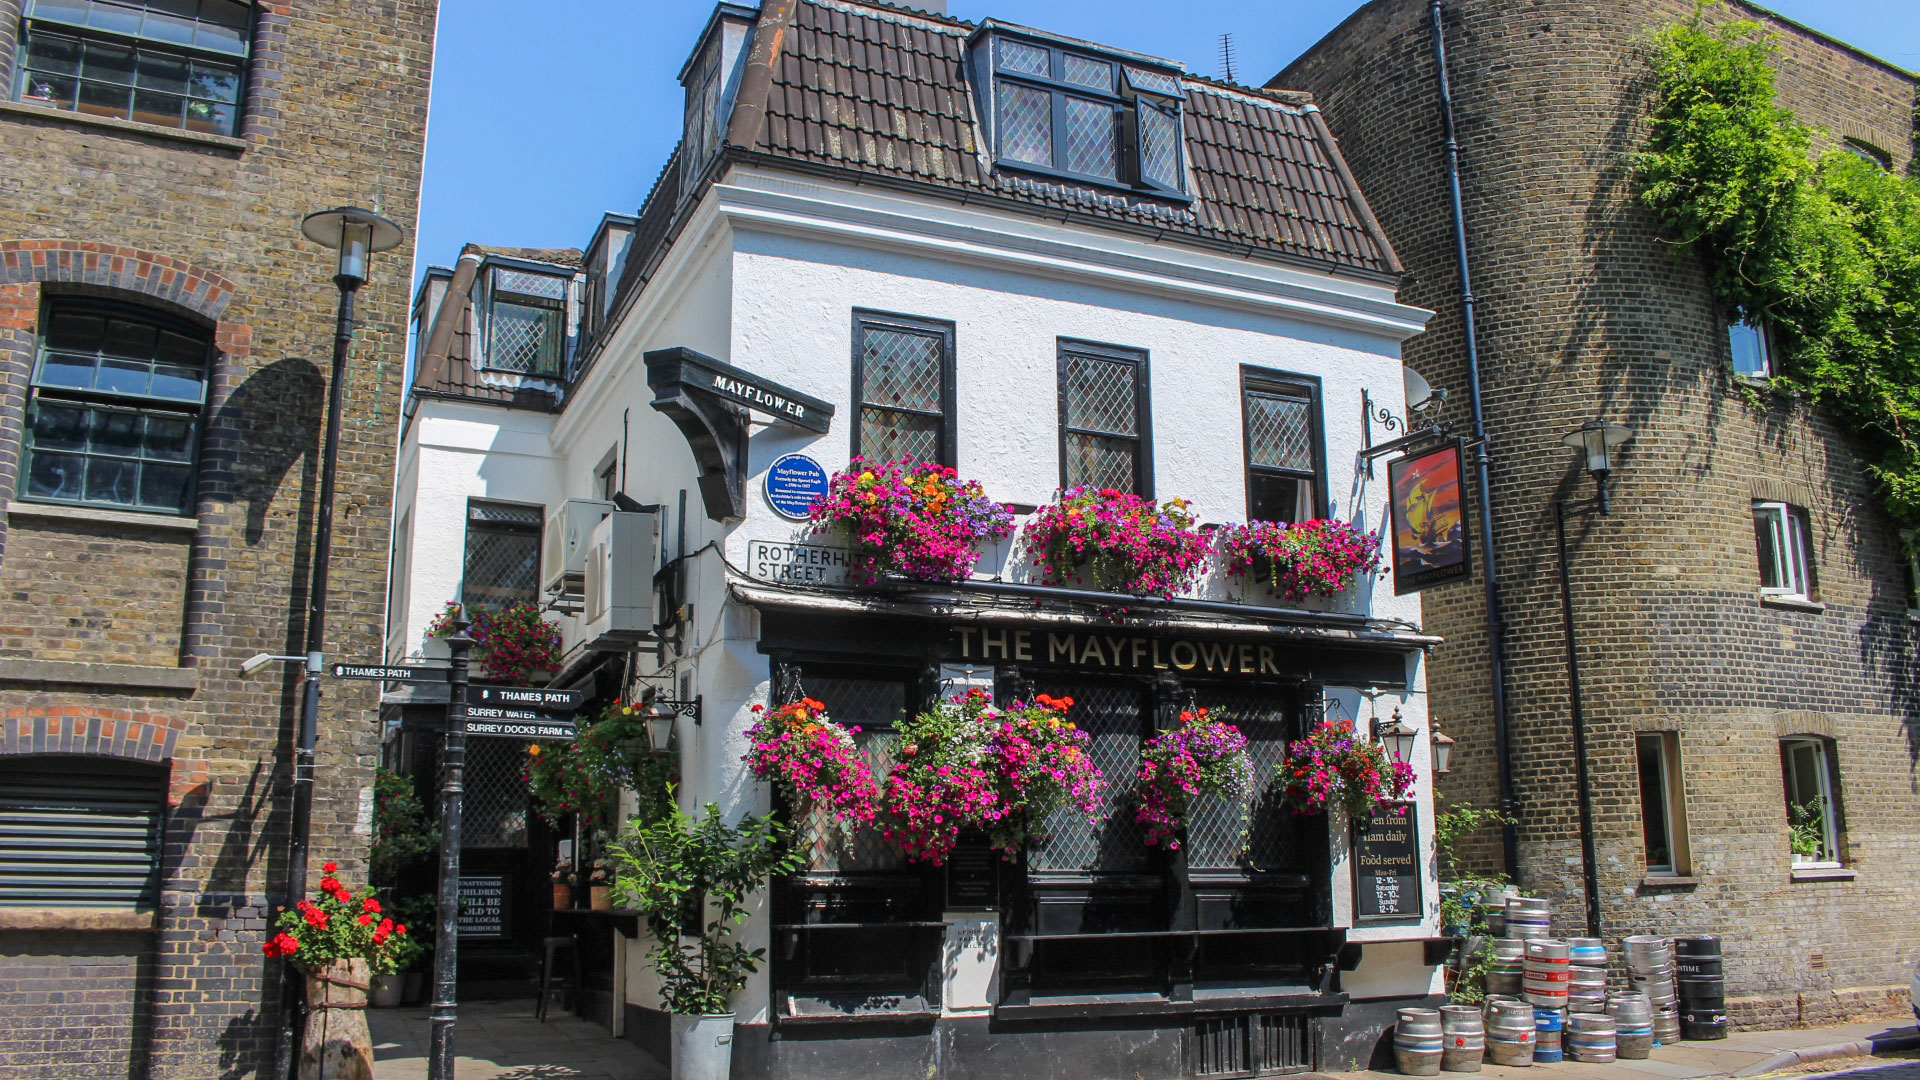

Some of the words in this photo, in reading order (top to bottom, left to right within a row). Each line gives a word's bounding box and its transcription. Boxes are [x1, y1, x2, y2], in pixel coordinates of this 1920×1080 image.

[713, 375, 805, 418] MAYFLOWER
[777, 468, 807, 476] Mayflower
[758, 545, 864, 567] ROTHERHIT
[758, 562, 826, 581] STREET
[952, 626, 1033, 661] THE
[1049, 633, 1280, 674] MAYFLOWER
[345, 667, 385, 677] THAMES
[387, 668, 411, 678] PATH
[500, 691, 542, 701] THAMES
[545, 693, 570, 703] PATH
[467, 707, 503, 718] SURREY
[505, 710, 536, 719] WATER
[466, 723, 503, 733] SURREY
[504, 725, 536, 735] DOCKS
[538, 726, 562, 736] FARM
[1386, 814, 1407, 825] from
[1386, 830, 1407, 844] daily
[1360, 854, 1381, 865] Food
[1383, 853, 1412, 865] served
[486, 907, 500, 915] TO
[1679, 965, 1700, 973] NTIME
